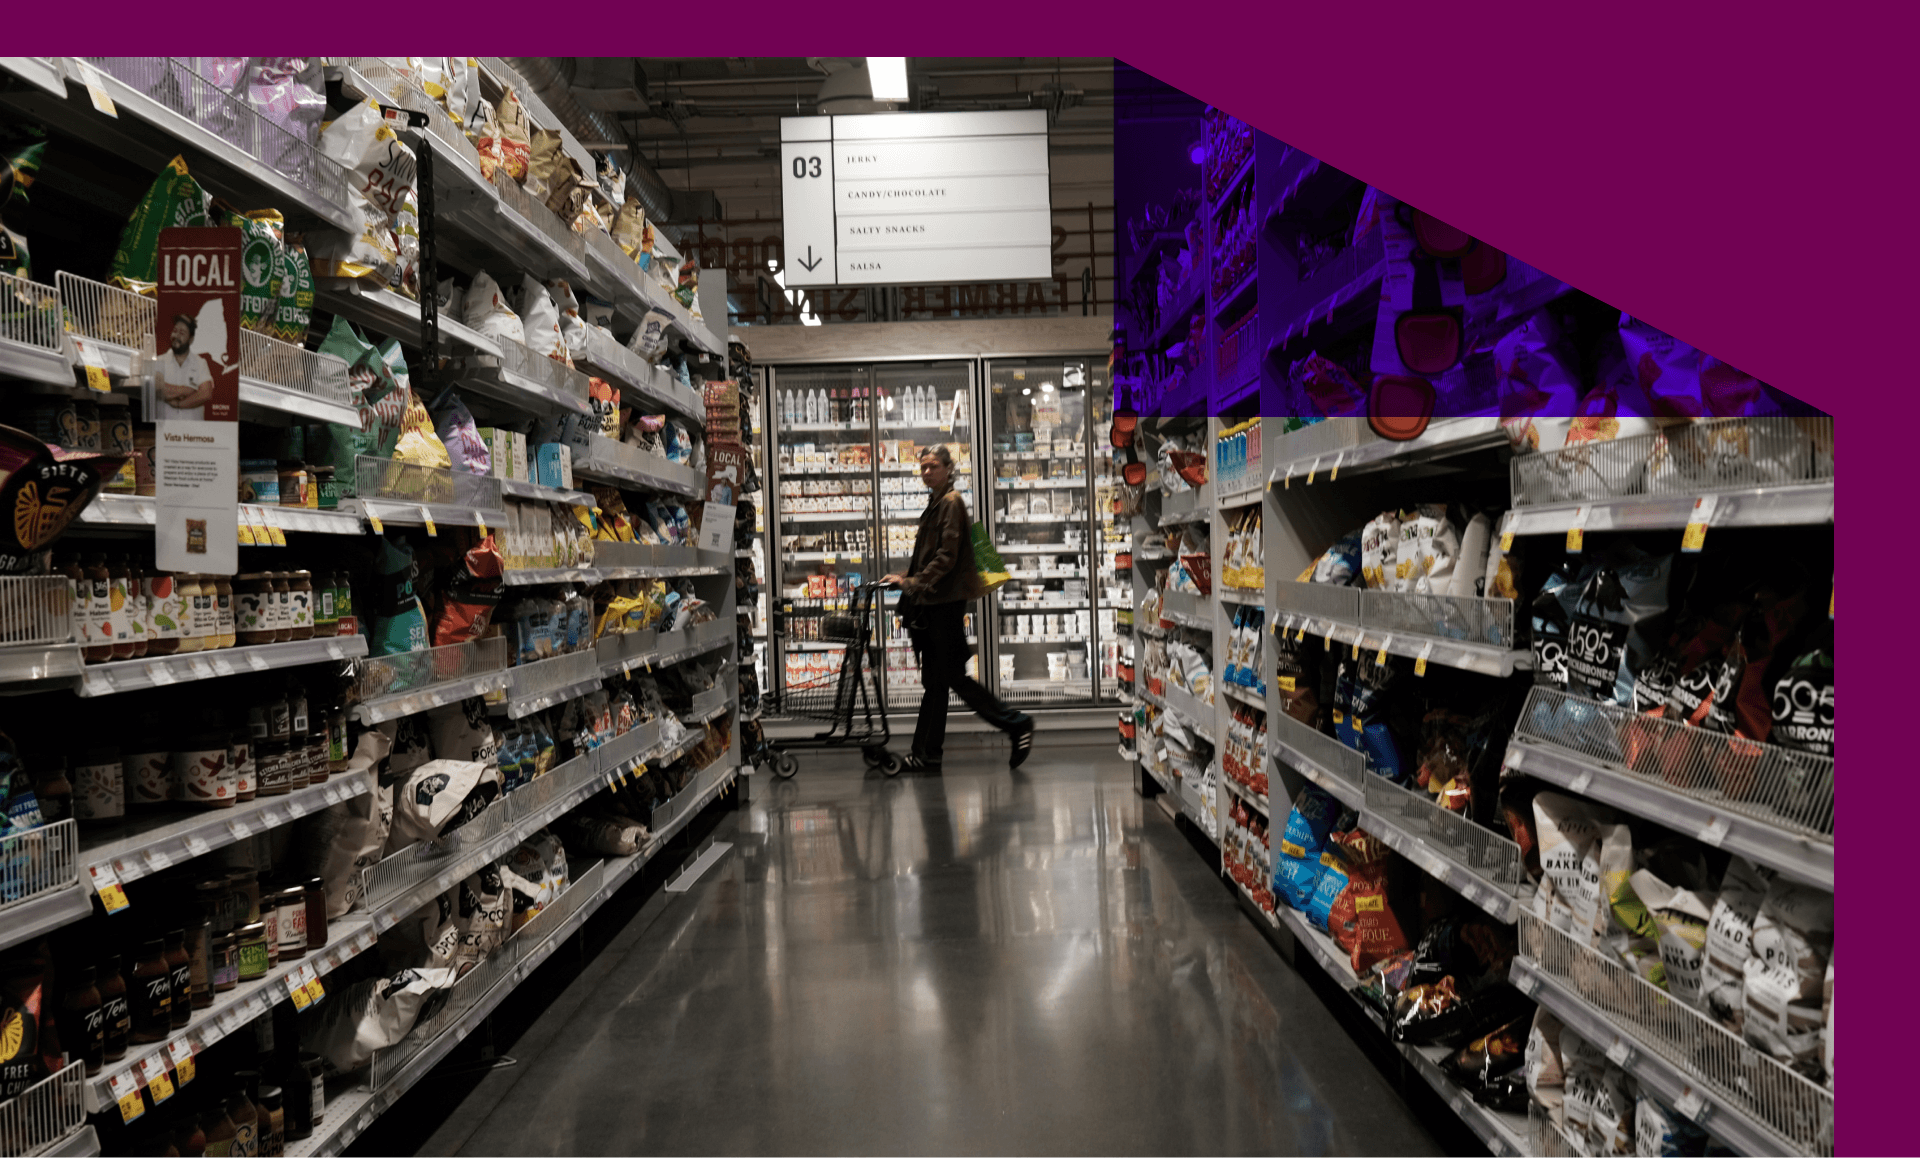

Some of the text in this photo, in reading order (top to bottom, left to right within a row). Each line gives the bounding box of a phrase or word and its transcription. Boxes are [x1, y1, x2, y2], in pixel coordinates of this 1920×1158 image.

[847, 155, 878, 164] JERKY
[793, 156, 822, 179] 03
[848, 189, 947, 199] CANDY/CHOCOLATE
[850, 225, 926, 235] SALTY SNACKS
[164, 254, 235, 287] LOCAL
[850, 262, 882, 271] SALSA
[164, 433, 215, 443] Vista Hermosa
[714, 451, 741, 466] LOCAL
[41, 464, 89, 485] SIETE
[1567, 621, 1614, 665] 4505
[4, 1064, 29, 1079] FREE
